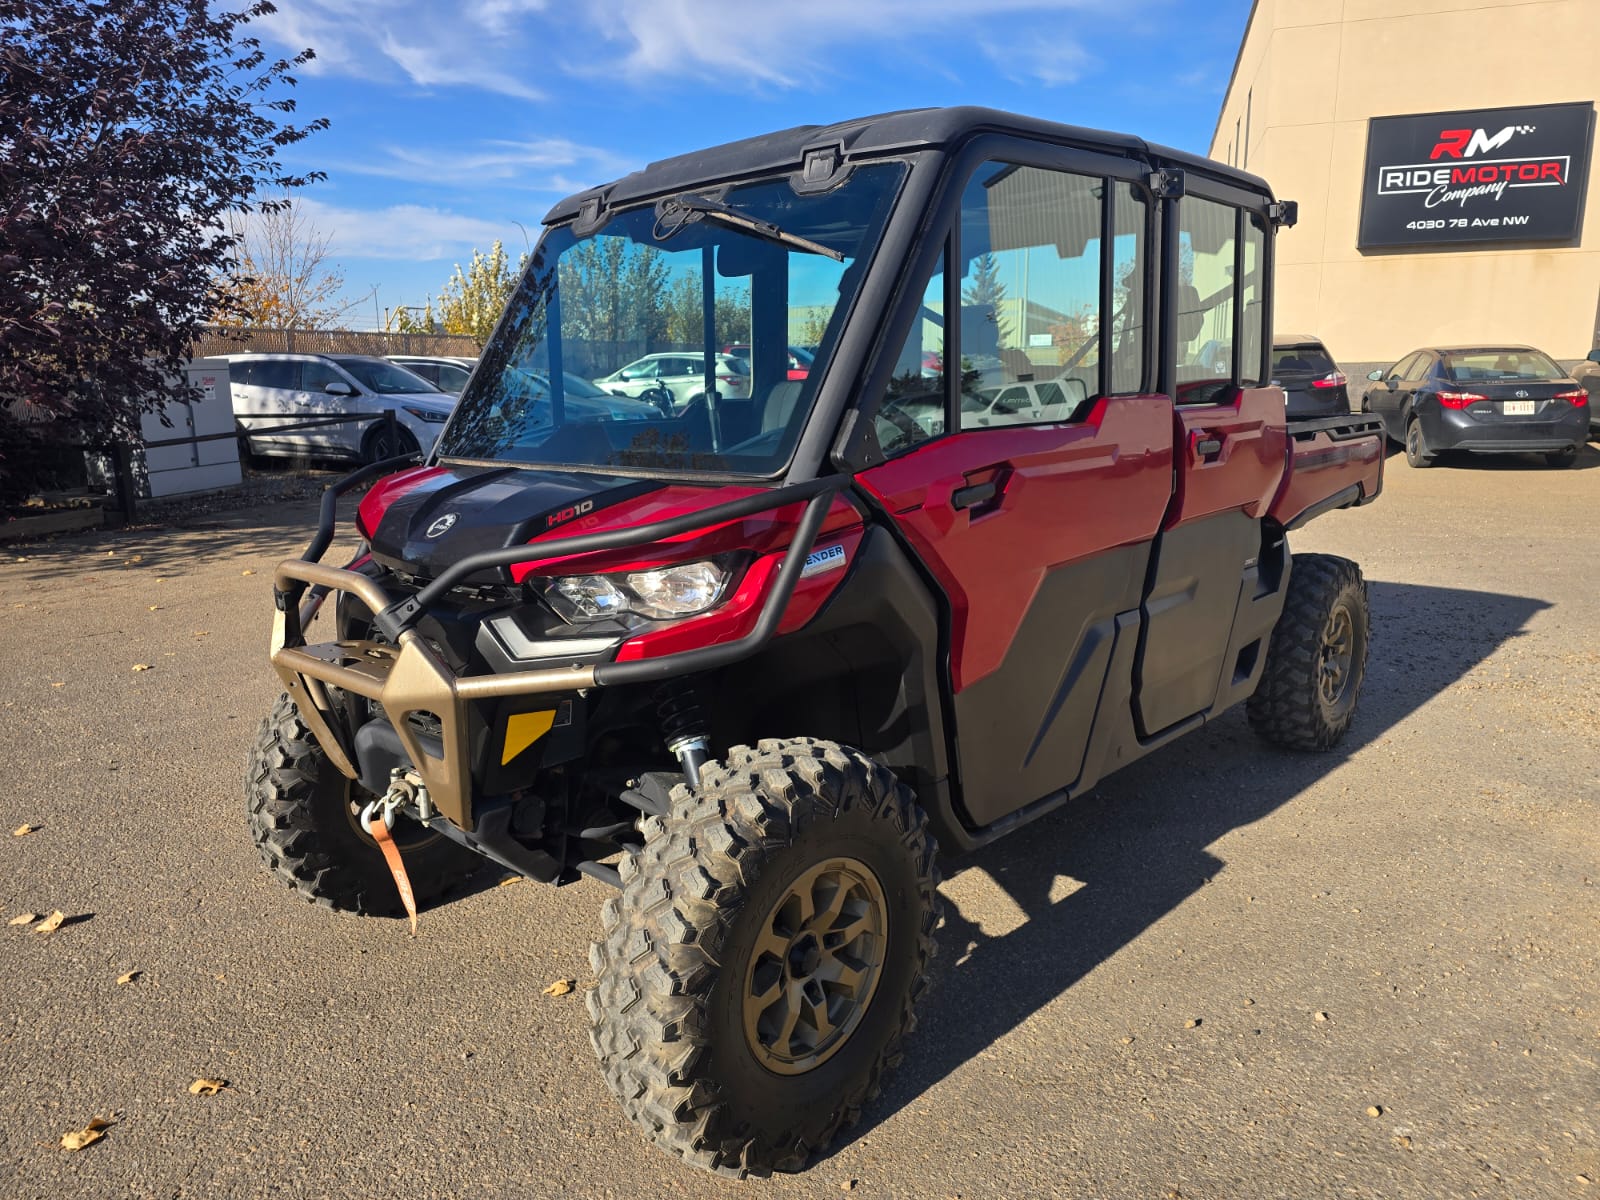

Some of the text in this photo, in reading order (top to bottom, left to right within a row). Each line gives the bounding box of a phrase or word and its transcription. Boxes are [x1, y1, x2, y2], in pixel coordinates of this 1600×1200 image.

[1430, 127, 1516, 159] RM
[1425, 181, 1508, 208] Company
[1406, 215, 1530, 231] 4030 78 Ave NW
[548, 500, 593, 527] HD10
[806, 546, 844, 566] ENDER
